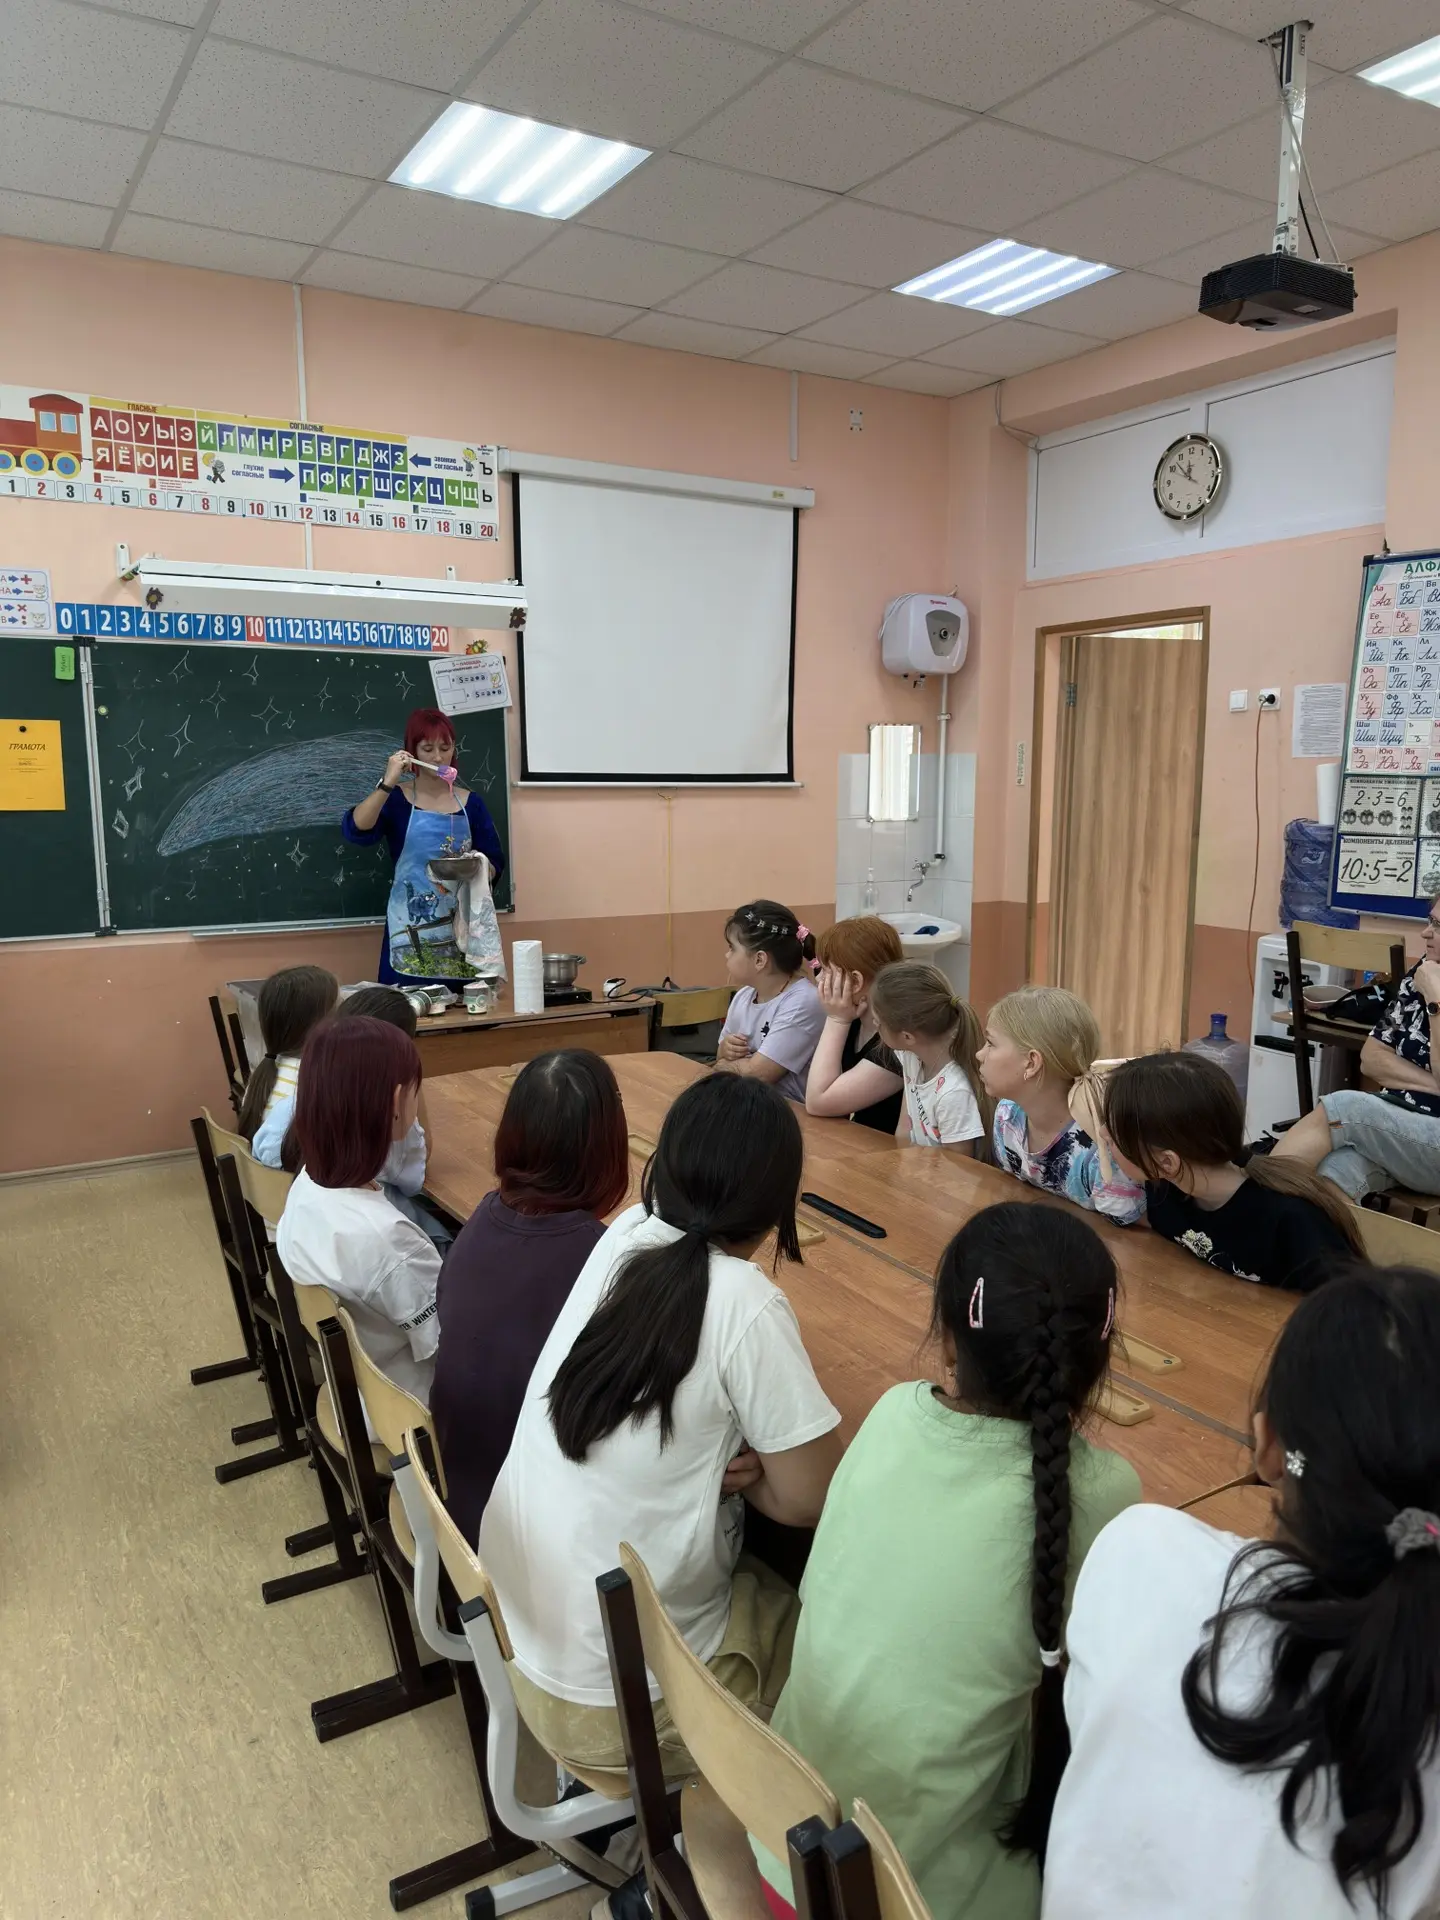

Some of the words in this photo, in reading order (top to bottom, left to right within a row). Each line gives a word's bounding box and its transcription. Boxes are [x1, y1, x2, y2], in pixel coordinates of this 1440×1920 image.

[127, 403, 157, 413] ГЛАСНЫЕ
[94, 416, 109, 432] А
[115, 419, 130, 434] О
[137, 422, 150, 436] У
[156, 424, 174, 440] Ы
[180, 426, 193, 442] Э
[201, 425, 214, 444] Й
[221, 431, 234, 446] Л
[241, 434, 255, 449] М
[261, 436, 274, 452] Н
[282, 438, 292, 452] Р
[302, 440, 313, 454] Б
[321, 442, 332, 457] В
[340, 445, 349, 459] Г
[357, 447, 370, 464] Д
[374, 448, 389, 464] Ж
[394, 451, 404, 466] З
[289, 422, 324, 433] СОГЛАСНЫЕ
[96, 447, 110, 463] Я
[118, 446, 131, 465] Ё
[136, 452, 155, 468] Ю
[161, 454, 174, 470] И
[182, 457, 195, 472] Е
[303, 469, 314, 484] П
[320, 471, 334, 485] Ф
[341, 473, 351, 488] К
[359, 475, 369, 490] Т
[375, 477, 390, 492] Ш
[394, 480, 406, 494] С
[413, 482, 424, 496] Х
[430, 483, 442, 500] Ц
[448, 485, 458, 499] Ч
[464, 487, 478, 504] Щ
[8, 480, 15, 492] 1
[37, 482, 46, 496] 2
[66, 485, 75, 498] 3
[94, 488, 103, 501] 4
[122, 490, 130, 503] 5
[149, 493, 157, 506] 6
[175, 495, 184, 508] 7
[202, 497, 210, 510] 8
[227, 500, 235, 513] 9
[249, 502, 264, 516] 10
[274, 505, 287, 518] 11
[299, 507, 313, 520] 12
[323, 509, 337, 522] 13
[346, 512, 360, 524] 14
[369, 514, 383, 527] 15
[392, 516, 406, 528] 16
[415, 519, 428, 530] 17
[436, 521, 450, 533] 18
[459, 522, 472, 535] 19
[480, 524, 493, 537] 20
[60, 608, 72, 629] 0
[81, 609, 90, 630] 1
[100, 610, 112, 631] 2
[120, 610, 131, 632] 3
[139, 612, 151, 633] 4
[159, 613, 169, 634] 5
[177, 614, 189, 634] 6
[196, 614, 206, 635] 7
[214, 616, 224, 636] 8
[231, 616, 242, 636] 9
[247, 616, 264, 637] 10
[267, 618, 282, 638] 11
[286, 618, 304, 639] 12
[306, 620, 323, 639] 13
[326, 621, 342, 640] 14
[344, 622, 361, 642] 15
[363, 623, 378, 643] 16
[380, 624, 395, 644] 17
[397, 626, 413, 645] 18
[415, 626, 430, 646] 19
[432, 628, 448, 647] 20
[8, 743, 46, 751] ГРАМОТА
